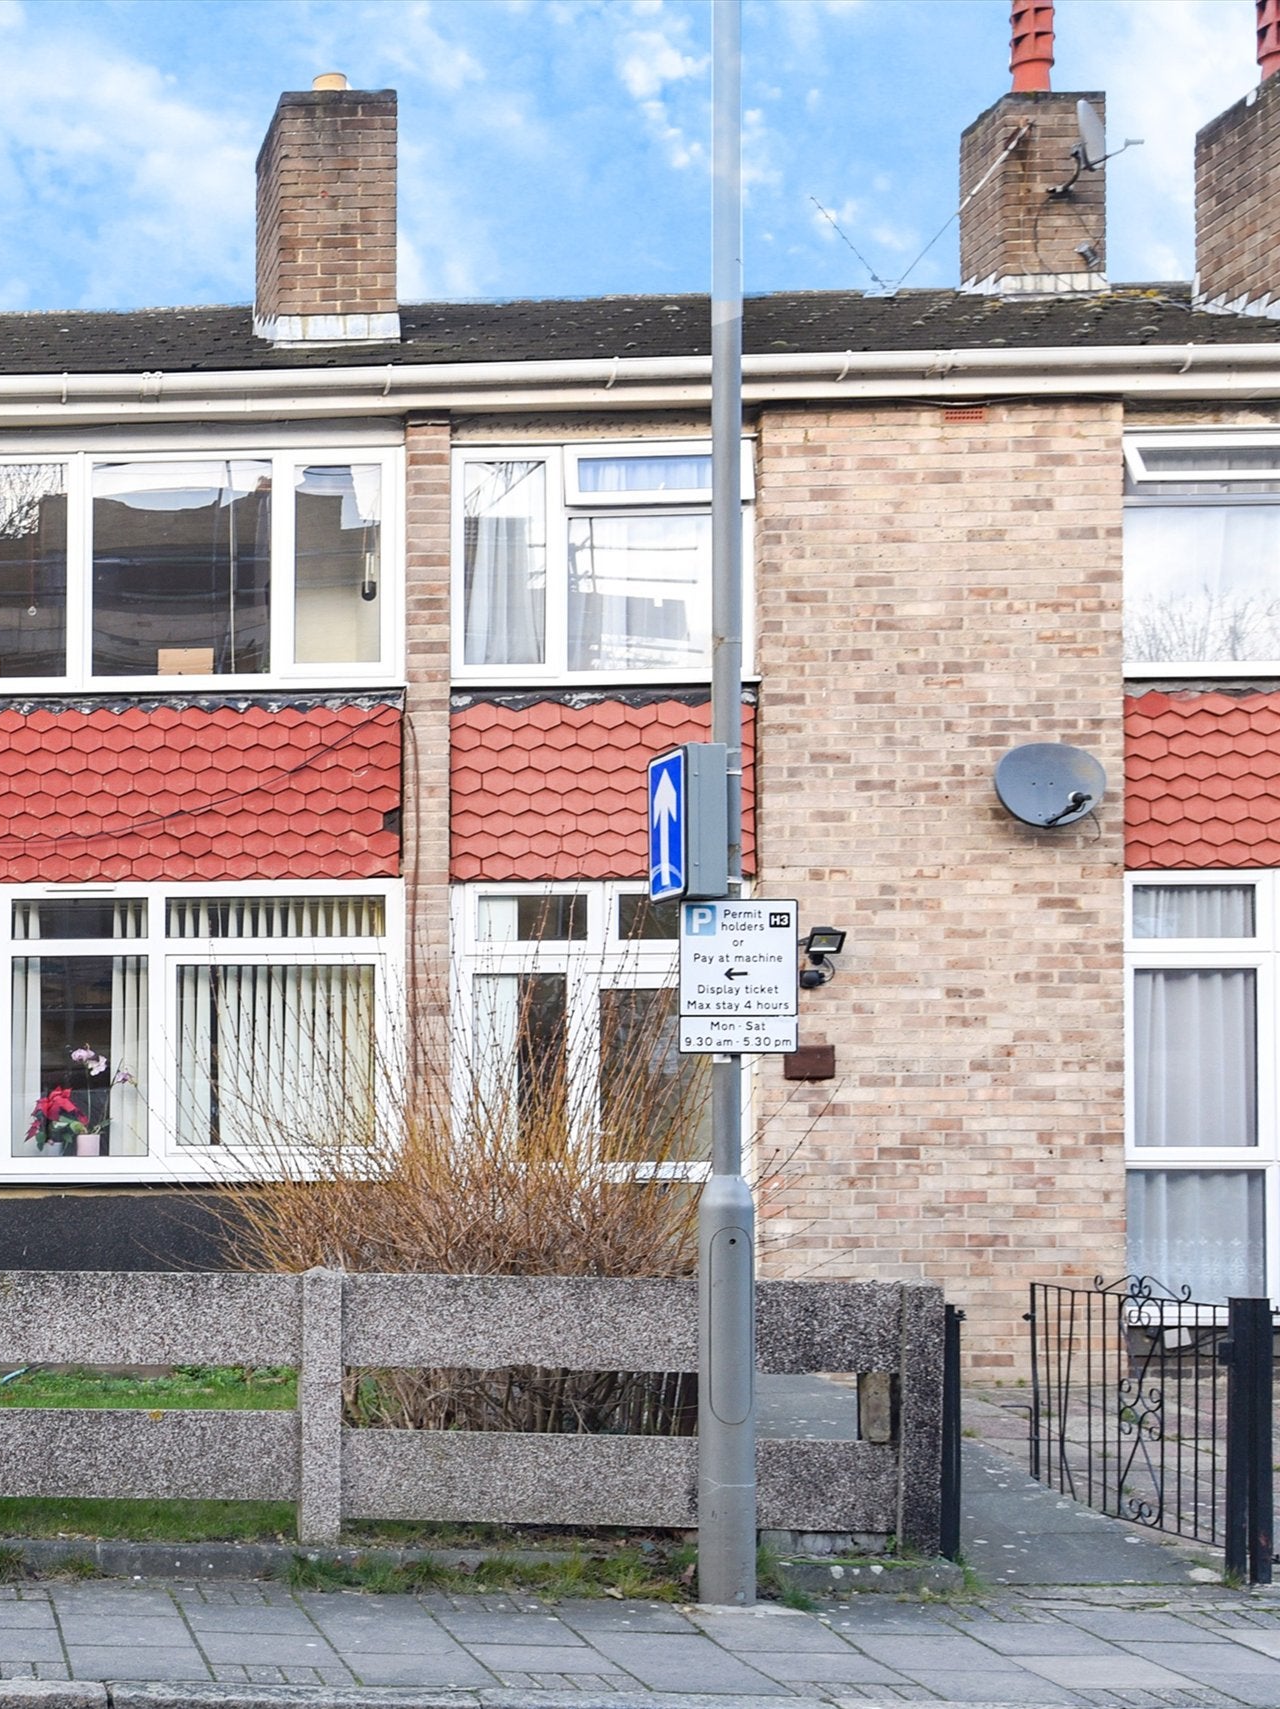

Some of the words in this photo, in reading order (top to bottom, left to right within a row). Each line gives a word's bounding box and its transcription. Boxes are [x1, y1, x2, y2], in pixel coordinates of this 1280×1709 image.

[723, 908, 762, 919] Permit
[692, 907, 713, 934] P
[770, 914, 789, 926] H3
[721, 921, 765, 931] holders
[732, 939, 744, 947] or
[693, 952, 714, 964] Pay
[718, 954, 730, 963] at
[735, 953, 783, 963] machine
[697, 984, 740, 995] Display
[745, 984, 779, 994] ticket
[687, 1000, 711, 1010] Max
[715, 1000, 740, 1012] stay
[743, 1000, 752, 1010] 4
[756, 1000, 790, 1010] hours
[710, 1021, 736, 1031] Mon
[745, 1020, 766, 1031] Sat
[684, 1036, 713, 1047] 9.30
[743, 1036, 771, 1047] 5.30
[774, 1039, 792, 1048] pm
